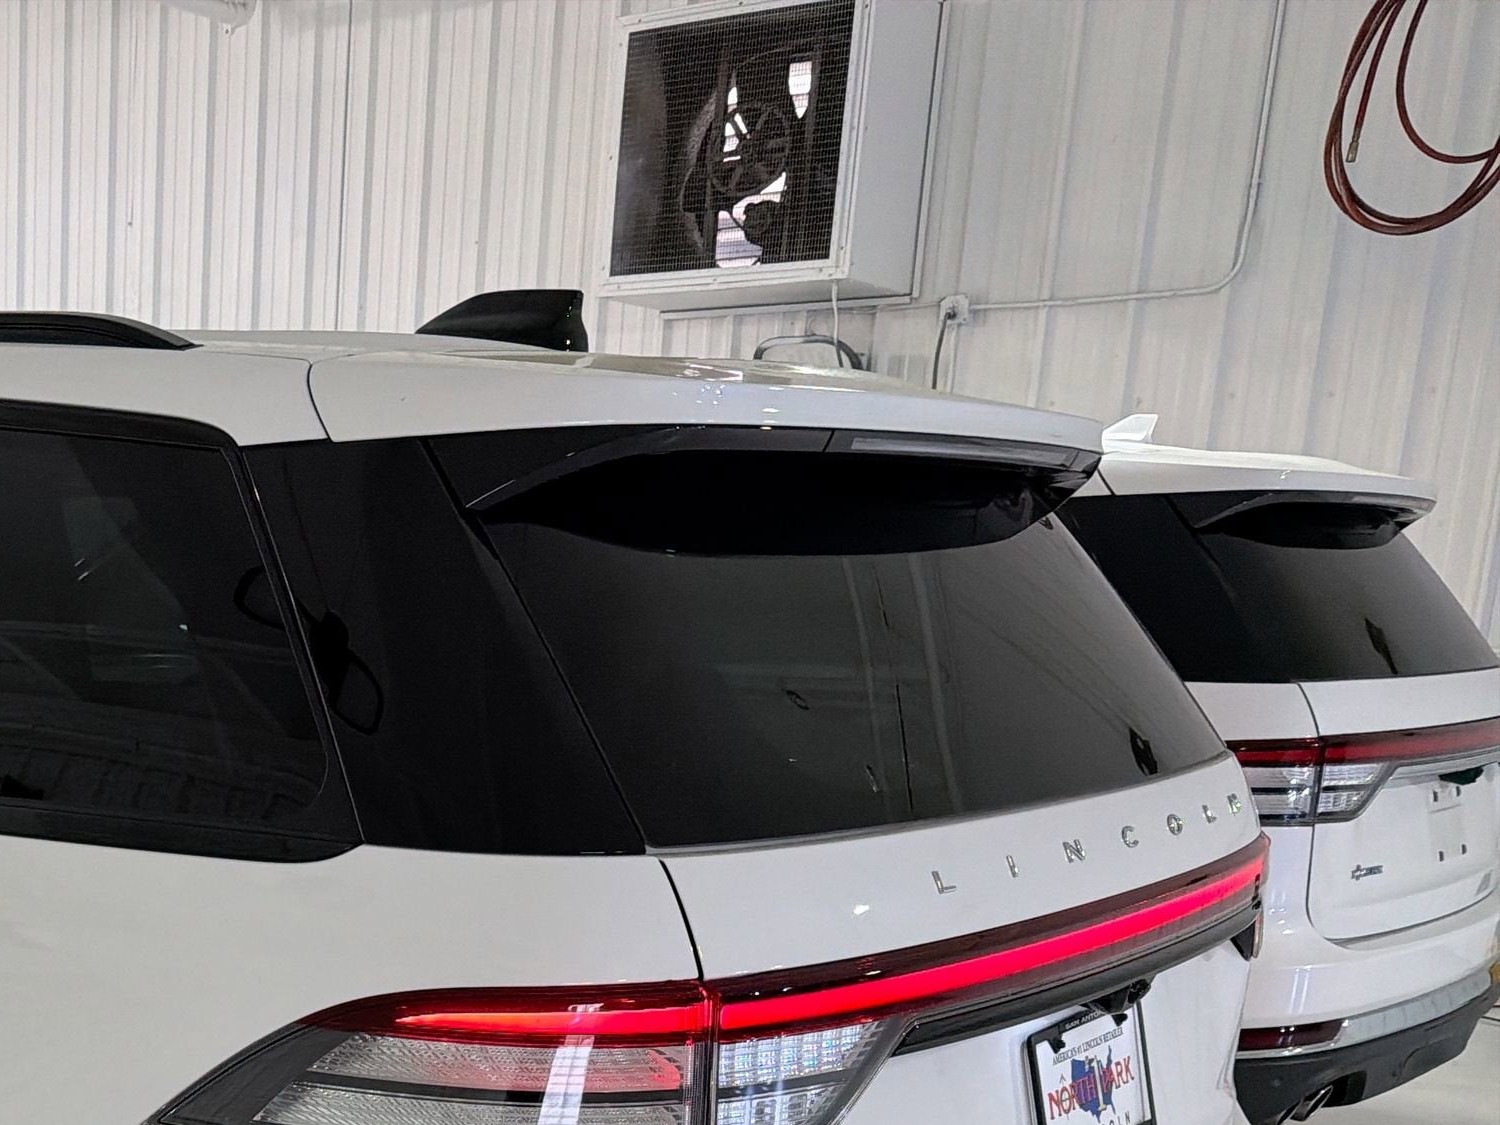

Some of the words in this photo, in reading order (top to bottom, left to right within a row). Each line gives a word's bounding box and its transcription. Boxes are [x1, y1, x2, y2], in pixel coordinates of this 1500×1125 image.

[931, 792, 1244, 895] LINCOLN
[1047, 1072, 1097, 1120] NORTH
[1101, 1055, 1135, 1093] PARK
